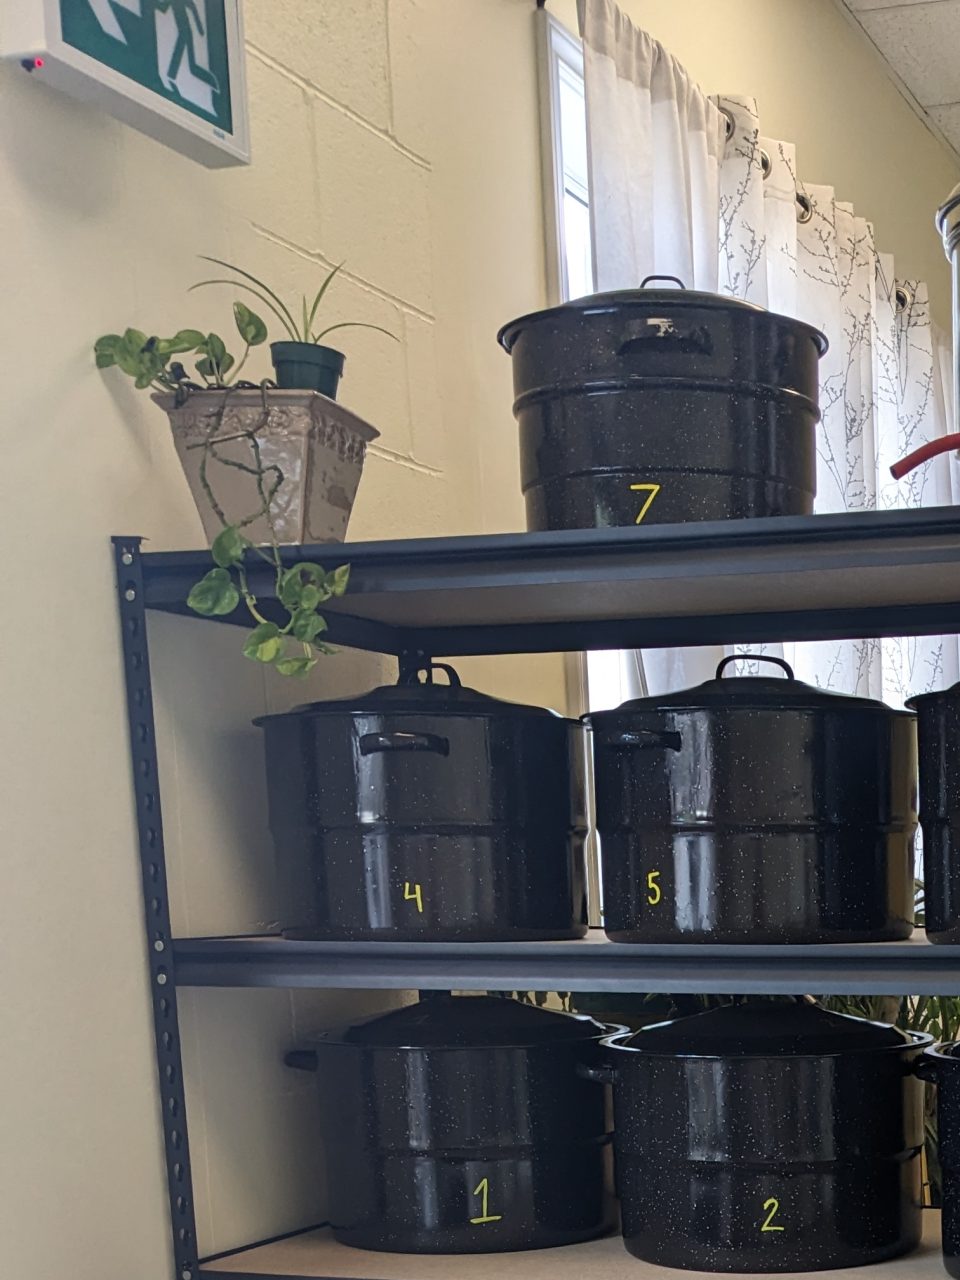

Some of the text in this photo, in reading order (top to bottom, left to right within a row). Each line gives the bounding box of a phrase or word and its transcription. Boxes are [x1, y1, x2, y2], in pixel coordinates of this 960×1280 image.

[629, 483, 661, 525] 7
[403, 881, 424, 913] 4
[647, 871, 662, 905] 5
[470, 1178, 502, 1224] 1
[760, 1197, 785, 1231] 2
